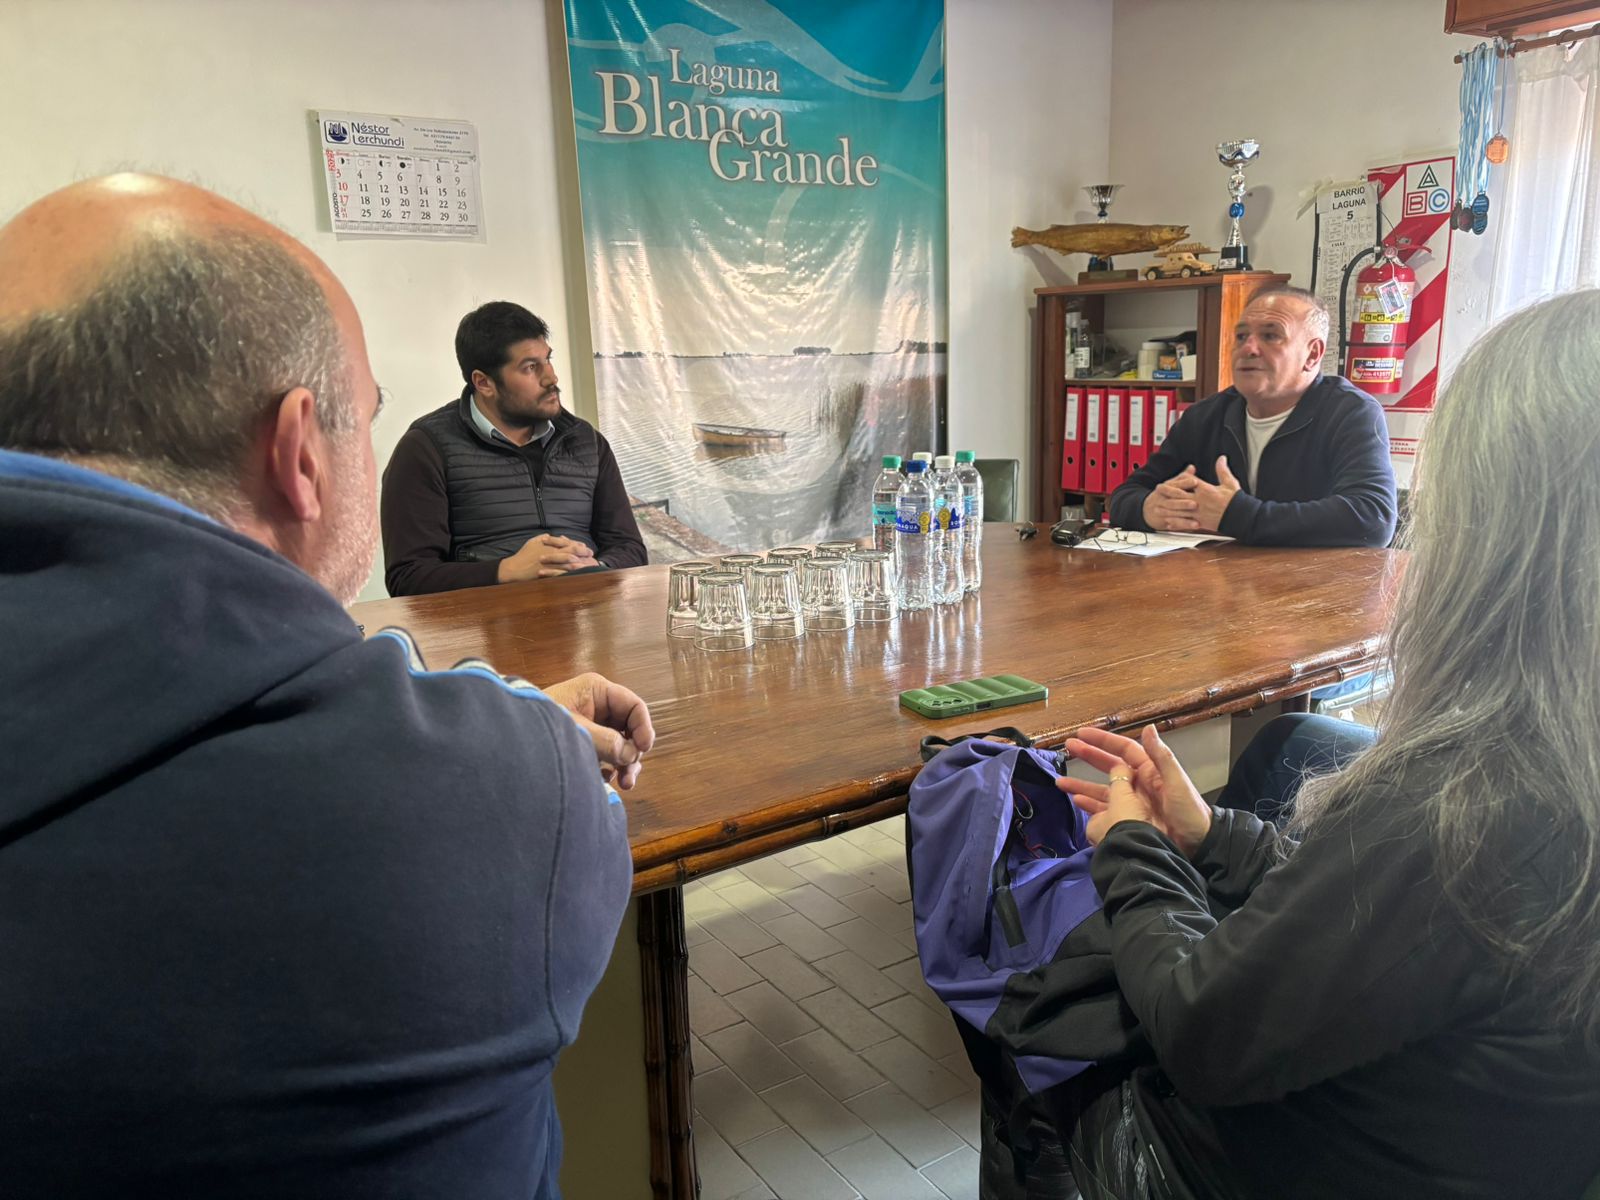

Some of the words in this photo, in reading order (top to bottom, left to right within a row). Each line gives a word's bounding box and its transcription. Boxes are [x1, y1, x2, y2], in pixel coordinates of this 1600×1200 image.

[668, 48, 781, 96] Laguna
[594, 70, 789, 148] Blanca
[351, 121, 389, 134] Néstor
[353, 133, 405, 148] Lerchundi
[708, 128, 879, 187] Grande
[436, 163, 441, 171] 1
[454, 164, 460, 173] 2
[336, 169, 342, 178] 3
[357, 169, 363, 179] 4
[377, 172, 383, 180] 5
[397, 172, 403, 182] 6
[417, 174, 422, 183] 7
[436, 175, 442, 184] 8
[455, 176, 460, 185] 9
[339, 182, 348, 191] 10
[360, 183, 369, 192] 11
[380, 184, 389, 193] 12
[399, 185, 409, 195] 13
[419, 186, 429, 195] 14
[438, 188, 448, 197] 15
[457, 188, 467, 197] 16
[1333, 186, 1366, 199] BARRIO
[332, 192, 341, 218] AGOSTO
[340, 195, 349, 205] 17
[361, 196, 371, 205] 18
[381, 197, 390, 206] 19
[400, 198, 410, 207] 20
[419, 199, 430, 207] 21
[439, 200, 449, 209] 22
[457, 201, 467, 210] 23
[1332, 198, 1367, 210] LAGUNA
[361, 209, 372, 218] 25
[382, 209, 392, 218] 26
[401, 210, 411, 220] 27
[420, 211, 431, 220] 28
[440, 212, 450, 221] 29
[458, 213, 469, 222] 30
[1346, 210, 1354, 220] 5
